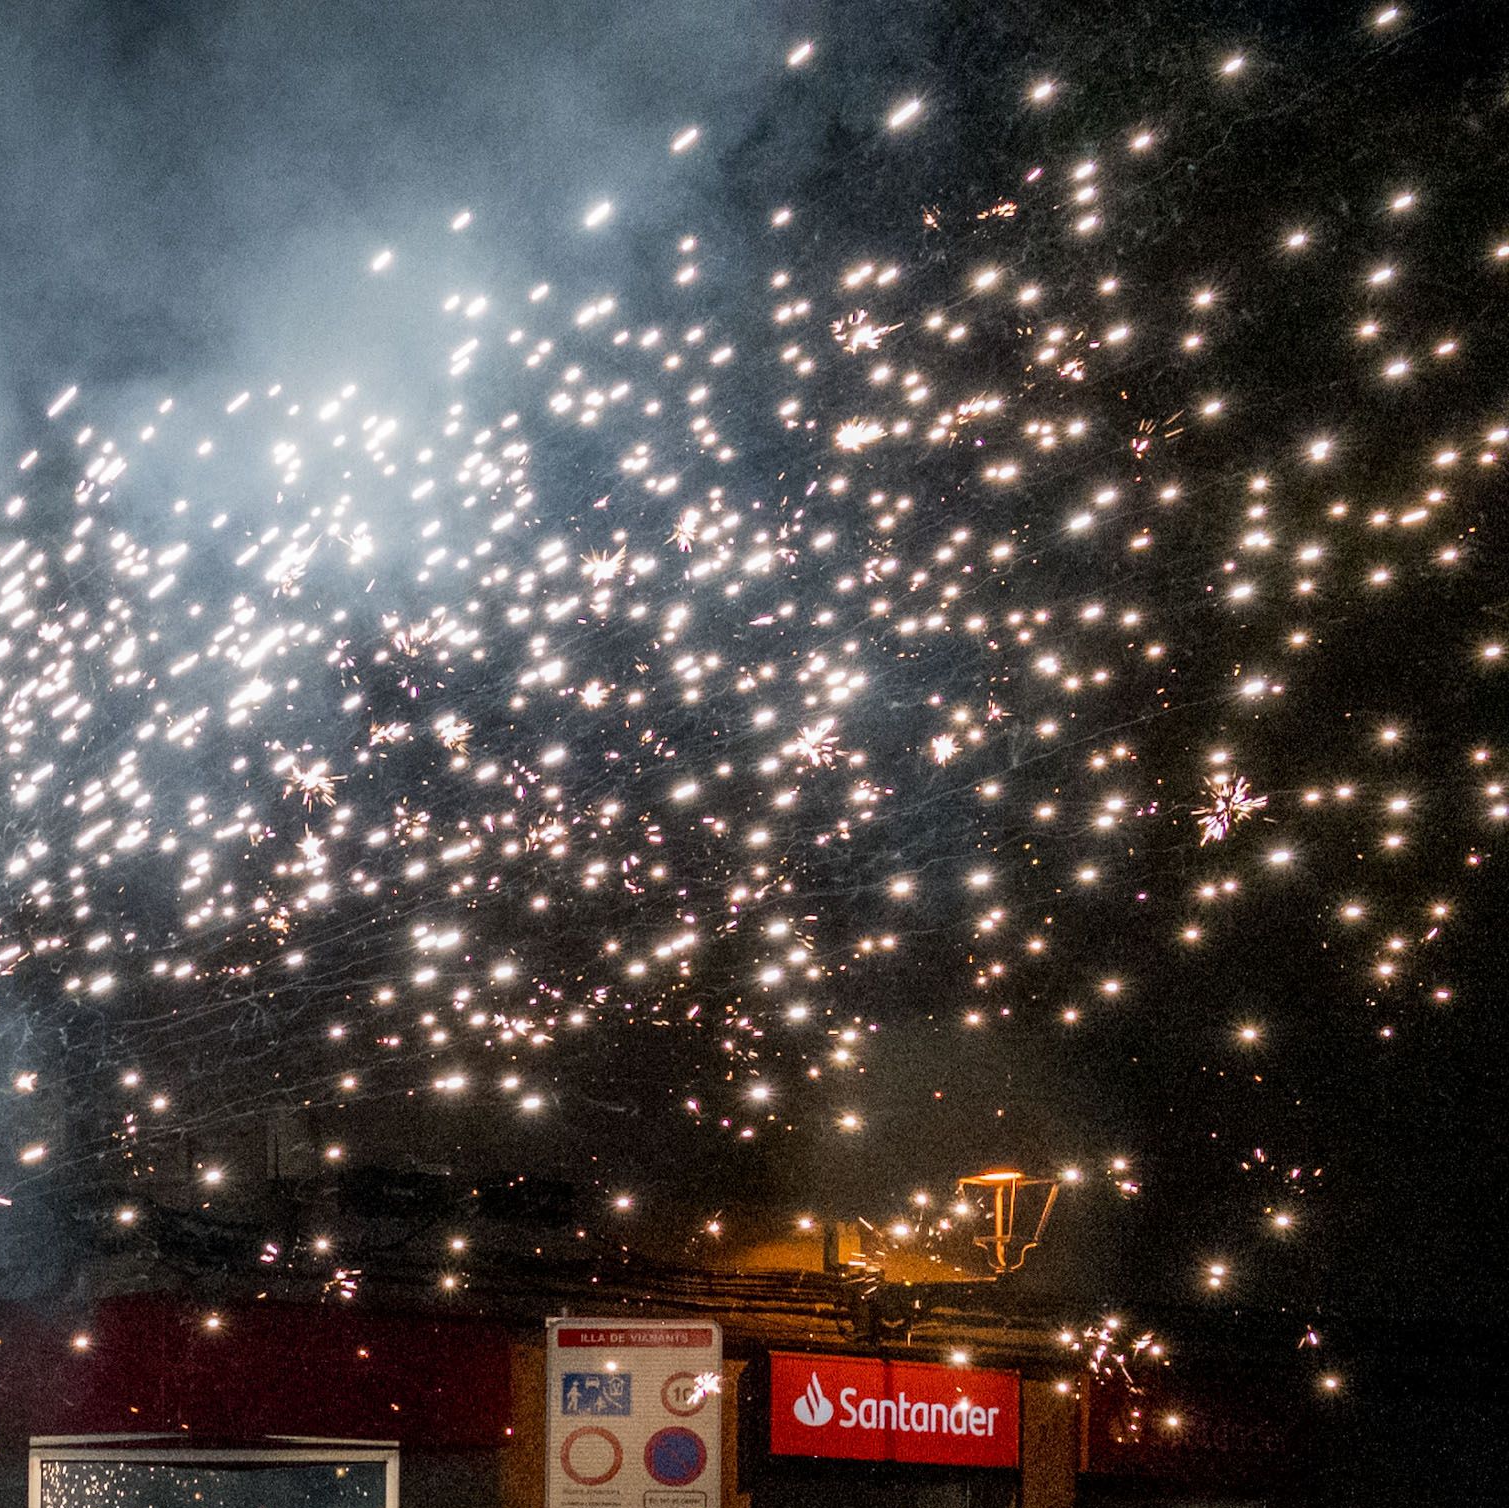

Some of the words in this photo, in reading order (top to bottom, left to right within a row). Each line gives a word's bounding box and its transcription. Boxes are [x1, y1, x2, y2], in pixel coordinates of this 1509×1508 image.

[580, 1333, 606, 1343] ILLA
[610, 1333, 625, 1343] DE
[630, 1333, 689, 1344] VIANANTS
[839, 1387, 1000, 1436] Santander
